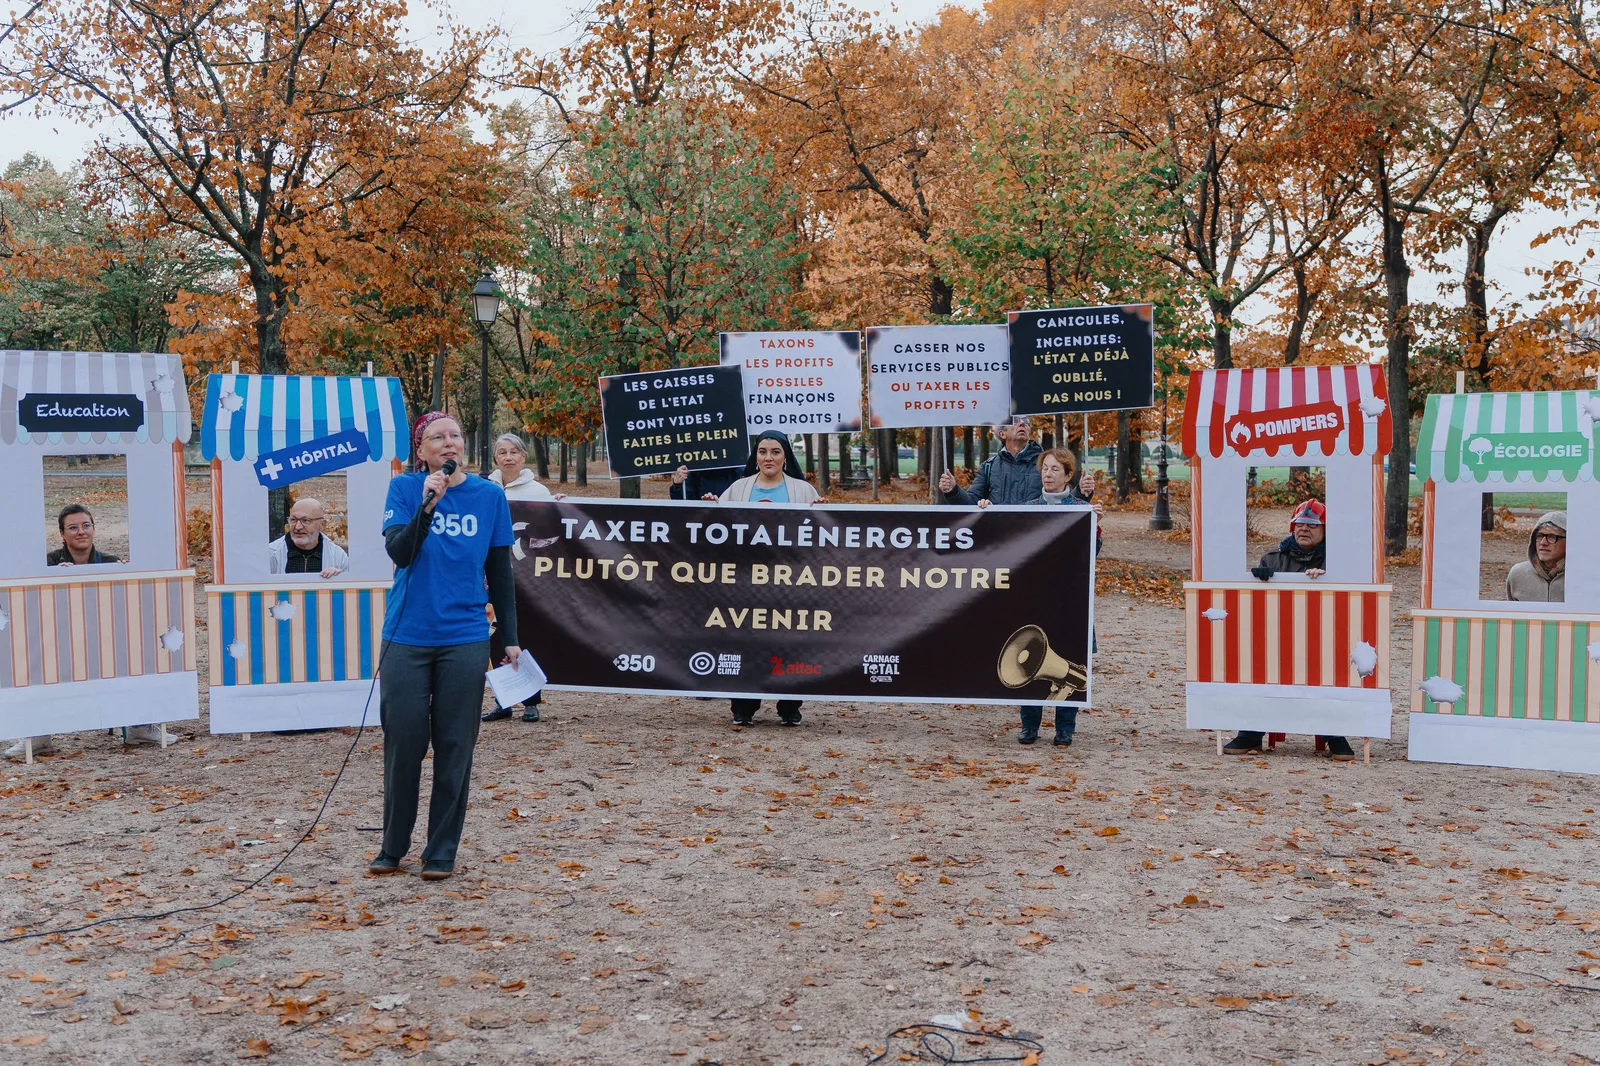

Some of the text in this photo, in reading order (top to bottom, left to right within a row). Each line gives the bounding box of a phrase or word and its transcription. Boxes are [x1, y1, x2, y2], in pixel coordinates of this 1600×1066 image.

[1037, 314, 1124, 328] CANICULES,
[760, 339, 815, 348] TAXONS
[894, 343, 985, 353] CASSER NOS
[1036, 334, 1121, 348] INCENDIES:
[746, 358, 834, 368] LES PROFITS
[1034, 347, 1129, 365] L'ÉTAT A DÉJÀ
[871, 362, 1009, 373] SERVICES PUBLICS
[624, 374, 714, 392] LES CAISSES
[758, 377, 823, 387] FOSSILES
[891, 382, 990, 392] OU TAXER LES
[639, 395, 704, 410] DE L'ETAT
[749, 392, 835, 406] FINANÇONS
[1043, 393, 1068, 404] PAS
[1075, 390, 1112, 402] NOUS
[36, 402, 130, 417] Education
[905, 400, 977, 410] PROFITS ?
[626, 412, 723, 431] SONT VIDES ?
[779, 413, 832, 424] DROITS
[1255, 412, 1338, 438] POMPIERS
[623, 428, 738, 448] FAITES LE PLEIN
[289, 441, 358, 469] HÔPITAL
[1495, 443, 1582, 458] ÉCOLOGIE
[634, 455, 671, 467] CHEZ
[676, 450, 717, 463] TOTAL
[431, 512, 478, 536] 350
[561, 518, 974, 550] TAXER TOTALÉNERGIES
[534, 553, 1010, 589] PLUTÔT QUE BRADER NOTRE
[705, 607, 832, 631] AVENIR
[617, 654, 655, 672] 350
[863, 655, 899, 663] CARNAGE
[786, 662, 822, 674] attac
